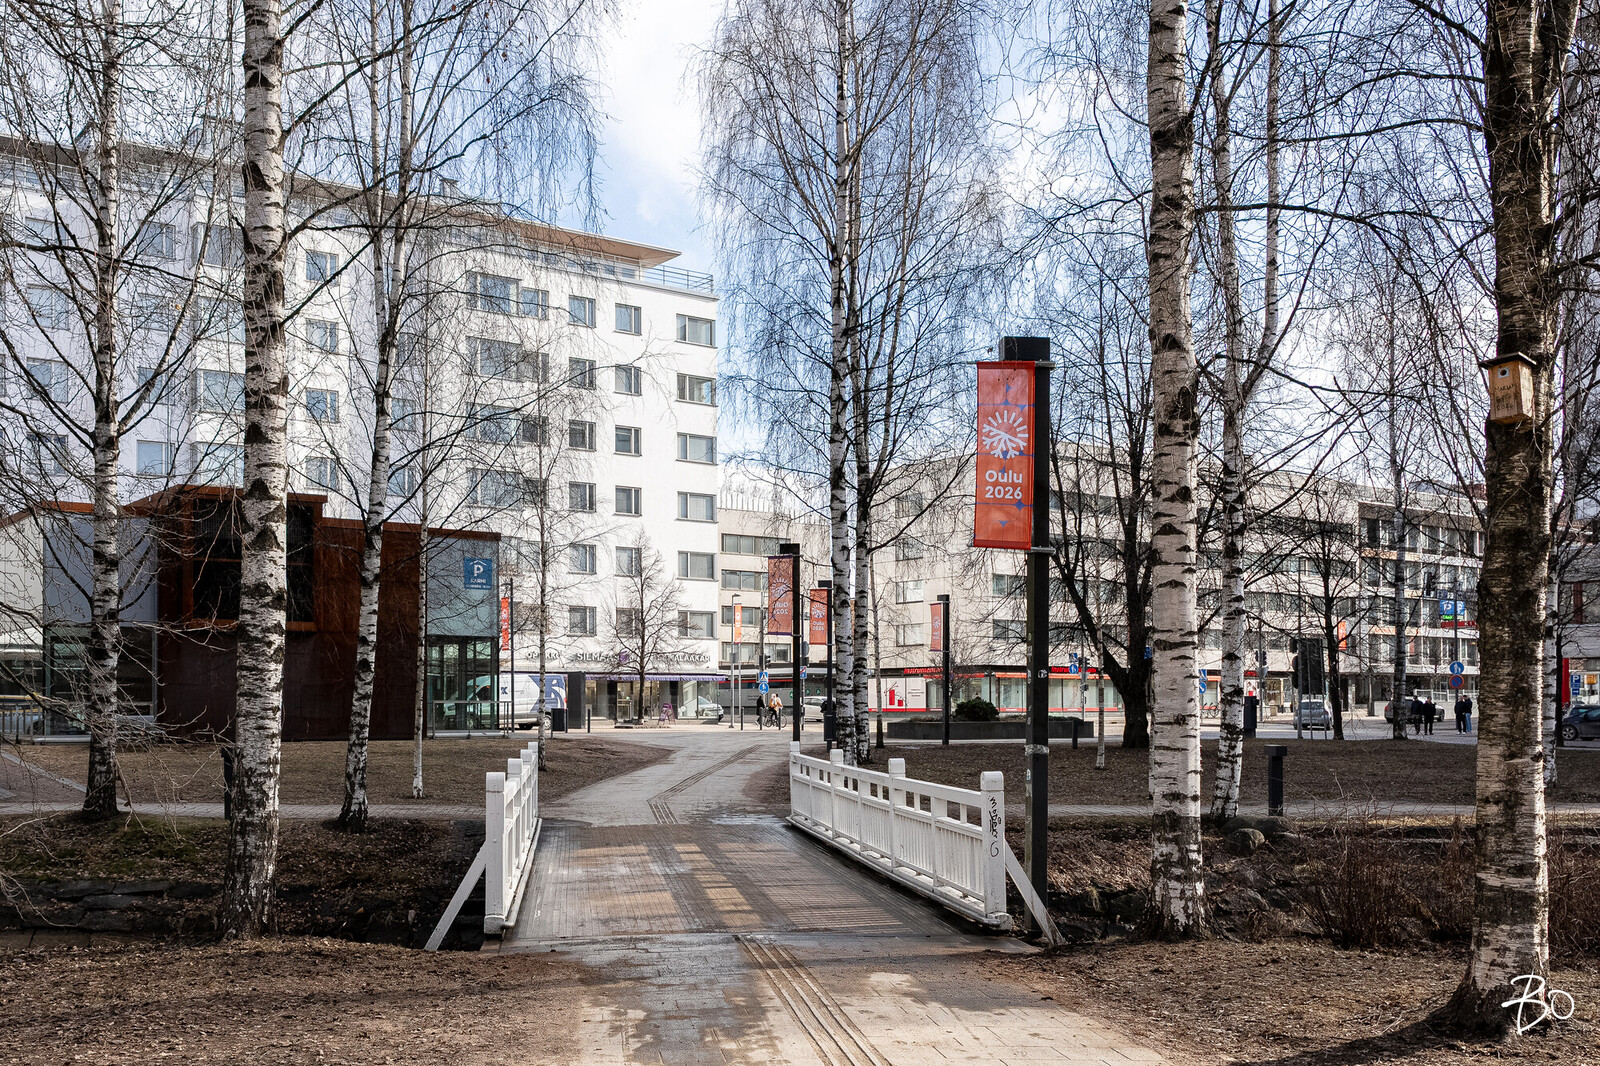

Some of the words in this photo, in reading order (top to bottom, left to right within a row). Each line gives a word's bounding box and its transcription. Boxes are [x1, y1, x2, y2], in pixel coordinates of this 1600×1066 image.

[985, 469, 1023, 483] Oulu
[984, 485, 1022, 499] 2026
[473, 564, 484, 577] P
